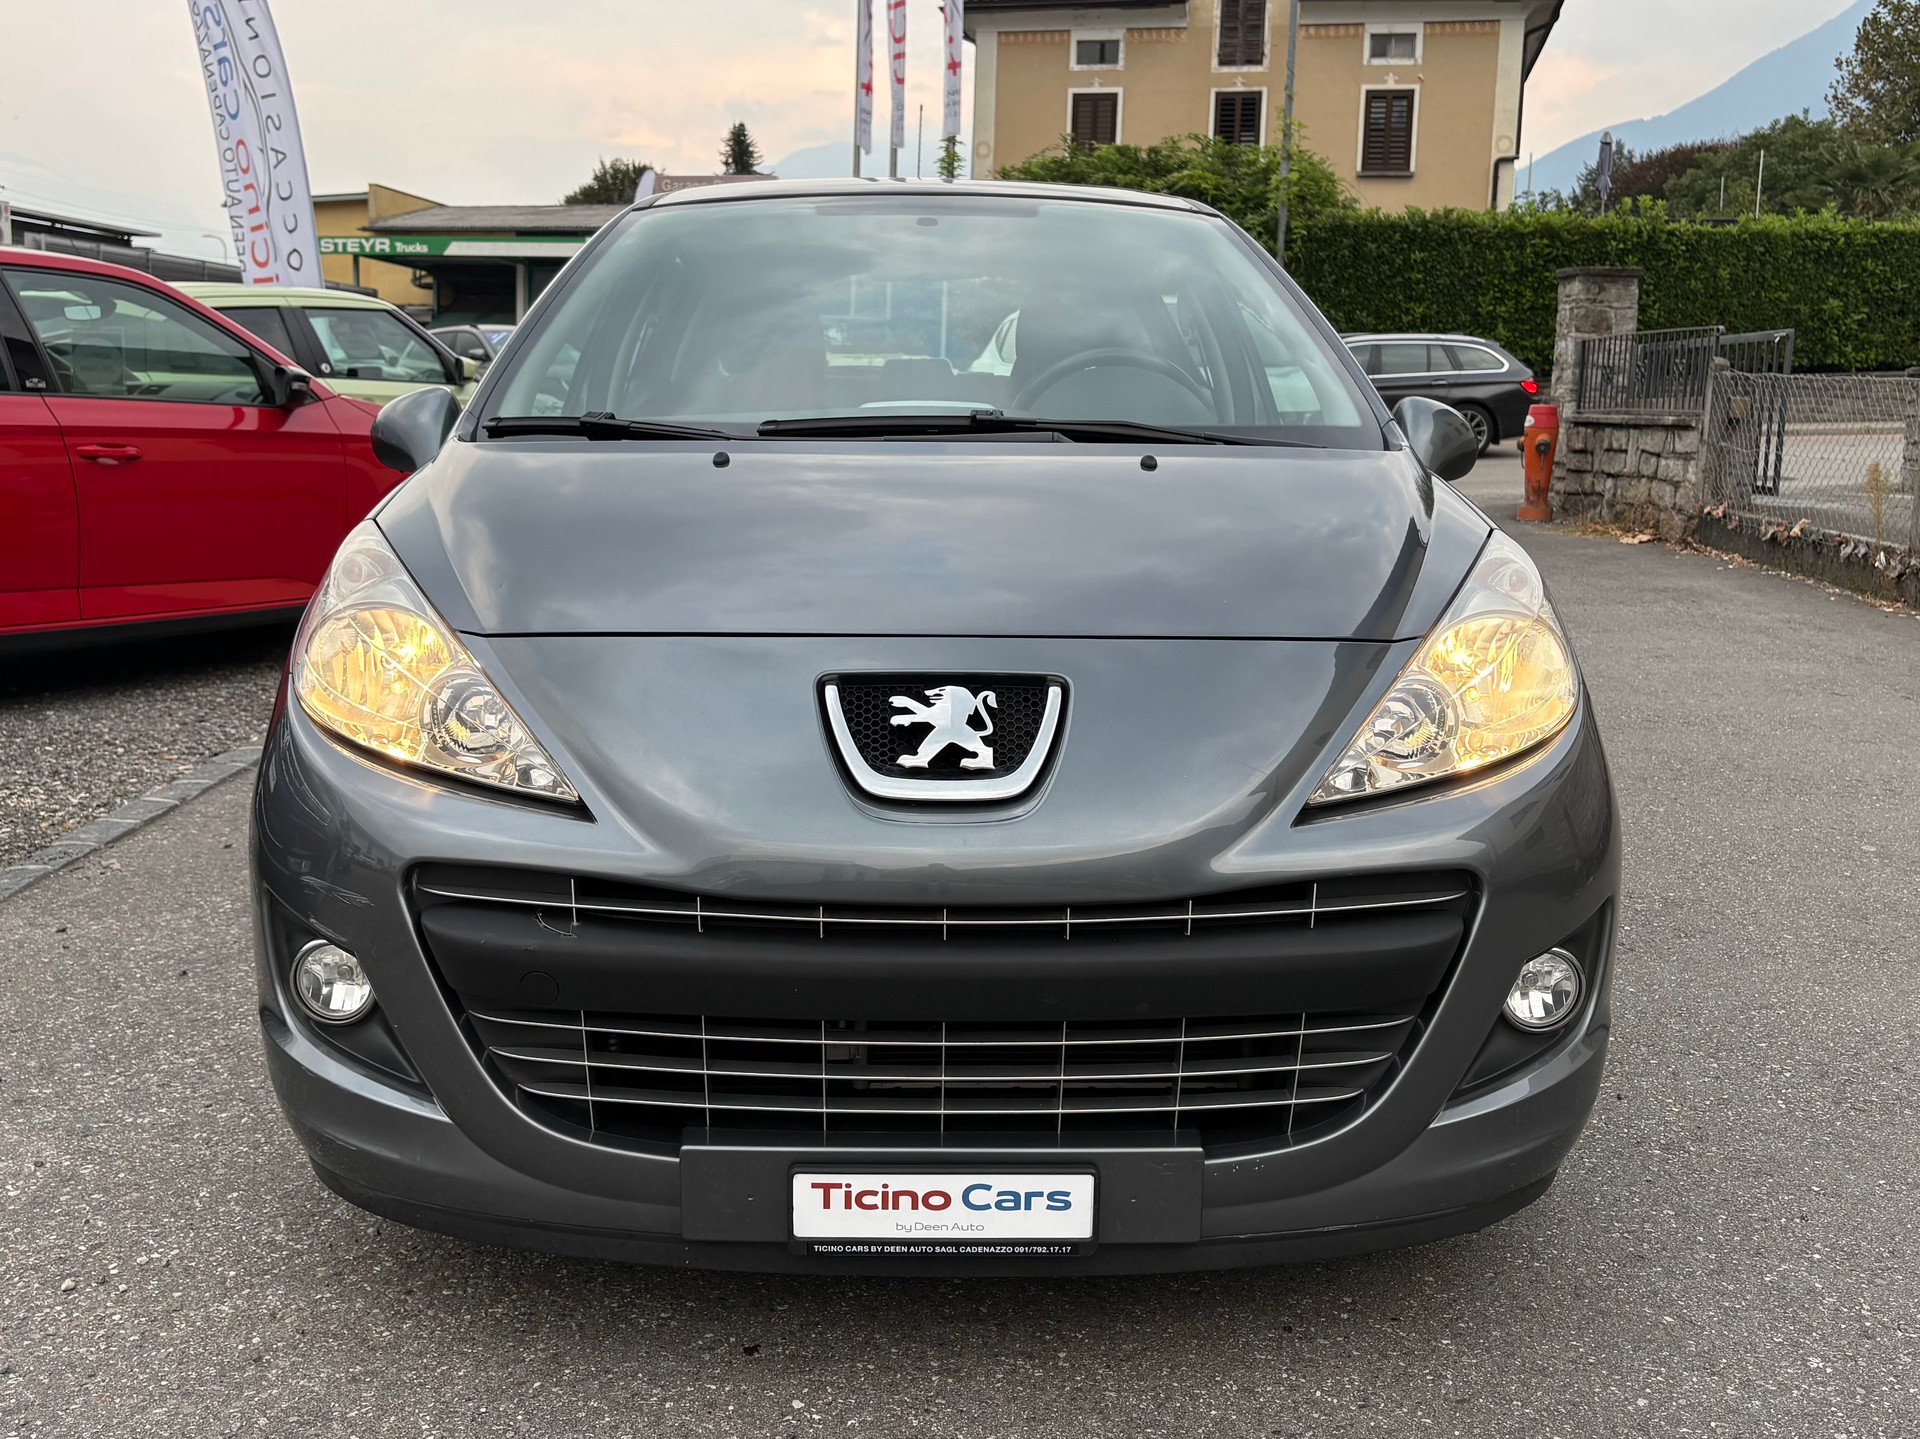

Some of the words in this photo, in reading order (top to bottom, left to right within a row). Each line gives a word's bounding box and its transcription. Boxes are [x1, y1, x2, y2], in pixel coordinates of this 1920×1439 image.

[320, 238, 390, 253] STEYR
[395, 241, 429, 253] Trucks
[811, 1182, 952, 1211] Ticino
[962, 1183, 1072, 1211] Cars
[895, 1222, 912, 1232] by
[914, 1222, 949, 1231] Deen
[951, 1222, 985, 1231] Auto
[813, 1245, 844, 1253] TICINO
[845, 1245, 870, 1253] CARS
[871, 1245, 883, 1253] BY
[884, 1245, 908, 1253] DEEN
[909, 1245, 934, 1253] AUTO
